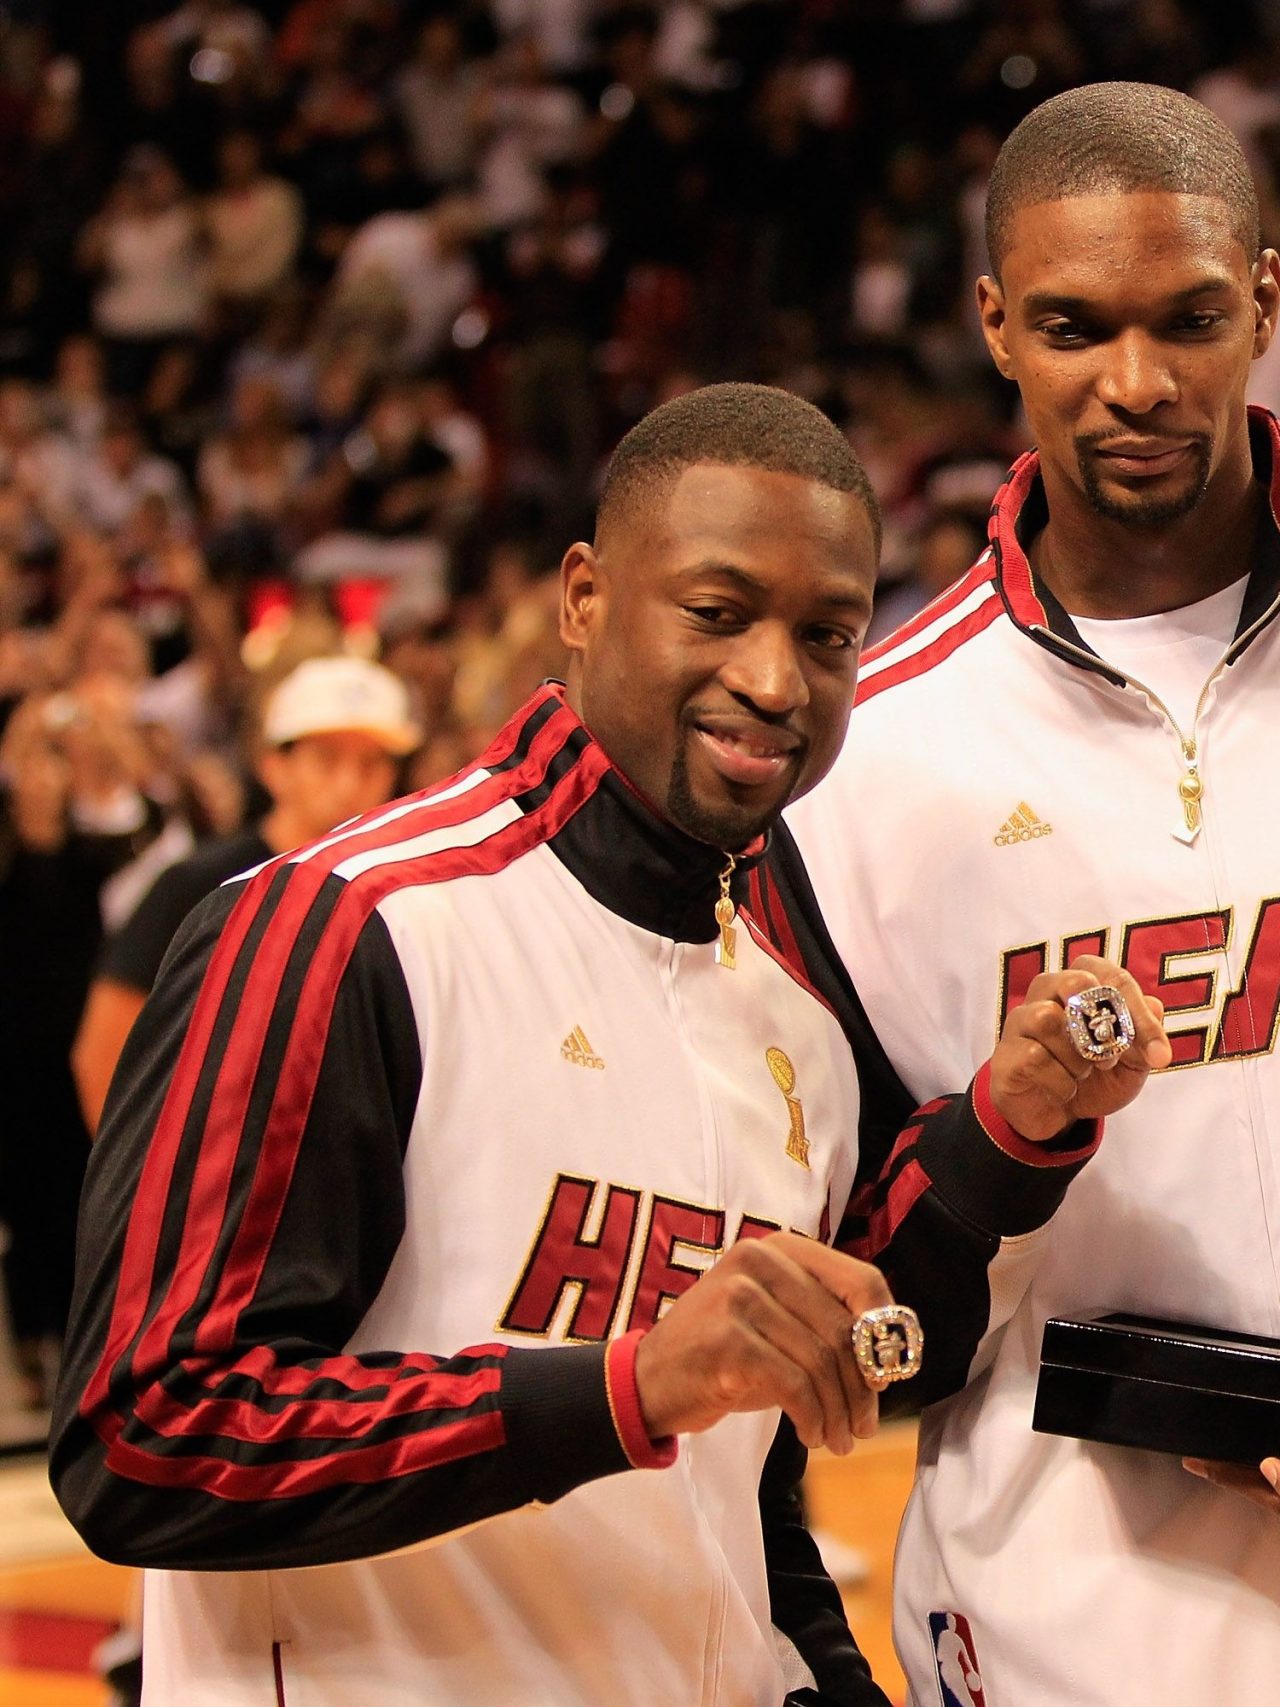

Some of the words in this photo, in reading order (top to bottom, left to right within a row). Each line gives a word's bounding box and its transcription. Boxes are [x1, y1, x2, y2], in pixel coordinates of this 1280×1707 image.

[994, 823, 1053, 848] adidas
[559, 1046, 606, 1071] adidas
[493, 1170, 831, 1344] HE
